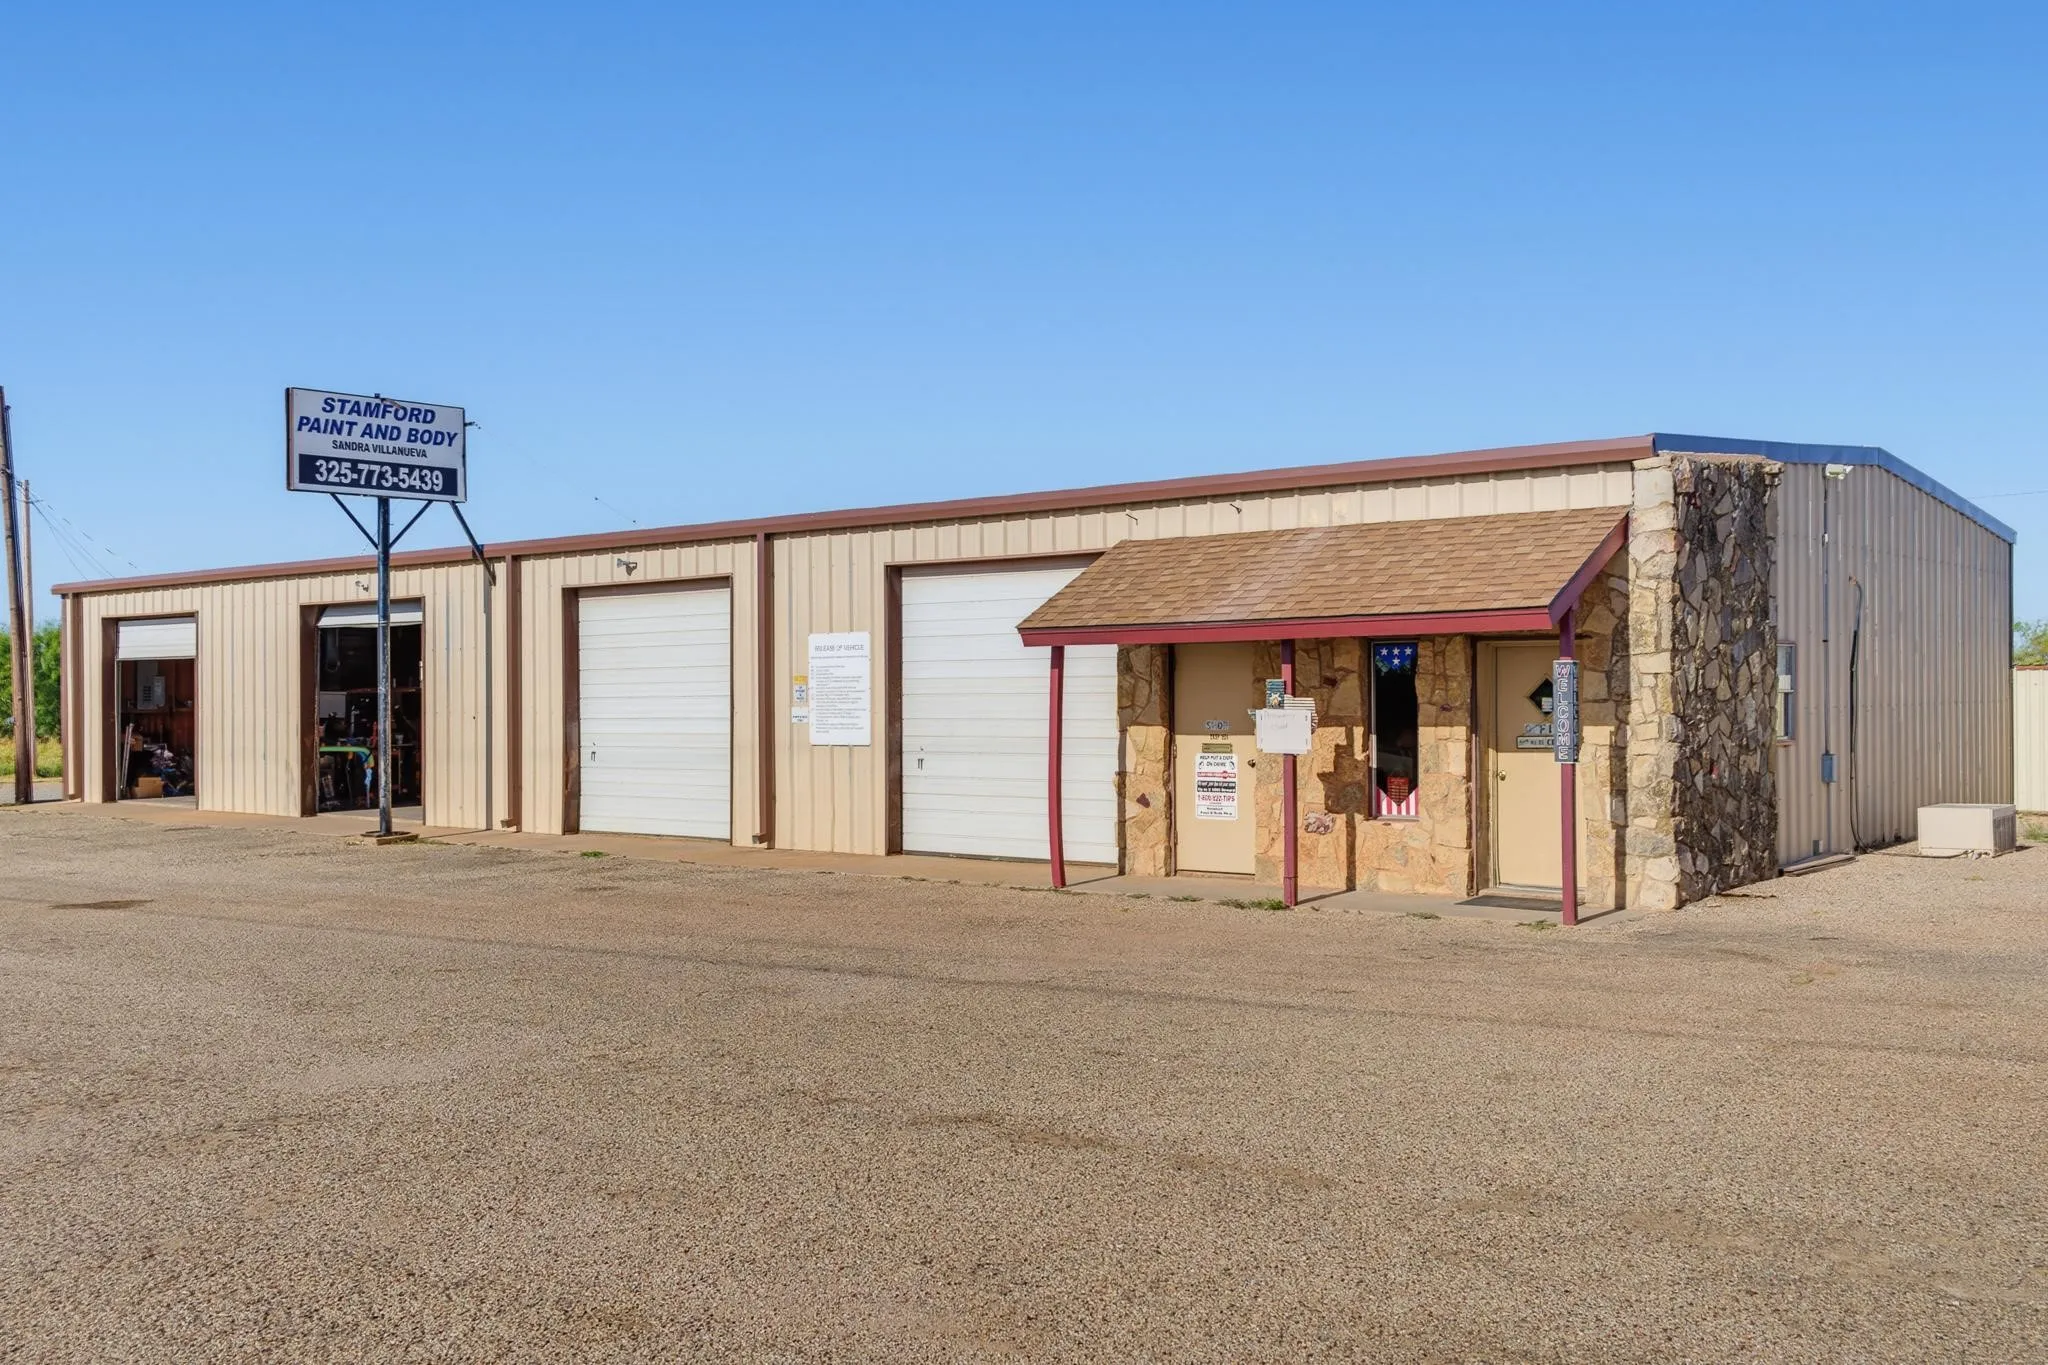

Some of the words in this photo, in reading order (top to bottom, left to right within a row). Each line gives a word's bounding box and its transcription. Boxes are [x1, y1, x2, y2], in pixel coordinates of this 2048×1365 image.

[321, 397, 436, 425] STAMFORD
[297, 416, 358, 437] PAINT
[360, 423, 402, 442] AND
[406, 428, 458, 447] BODY
[332, 440, 370, 453] SANDRA
[372, 444, 428, 458] VILLANUEVA
[315, 459, 444, 492] 325-773-5439
[1555, 664, 1571, 760] WELCOME
